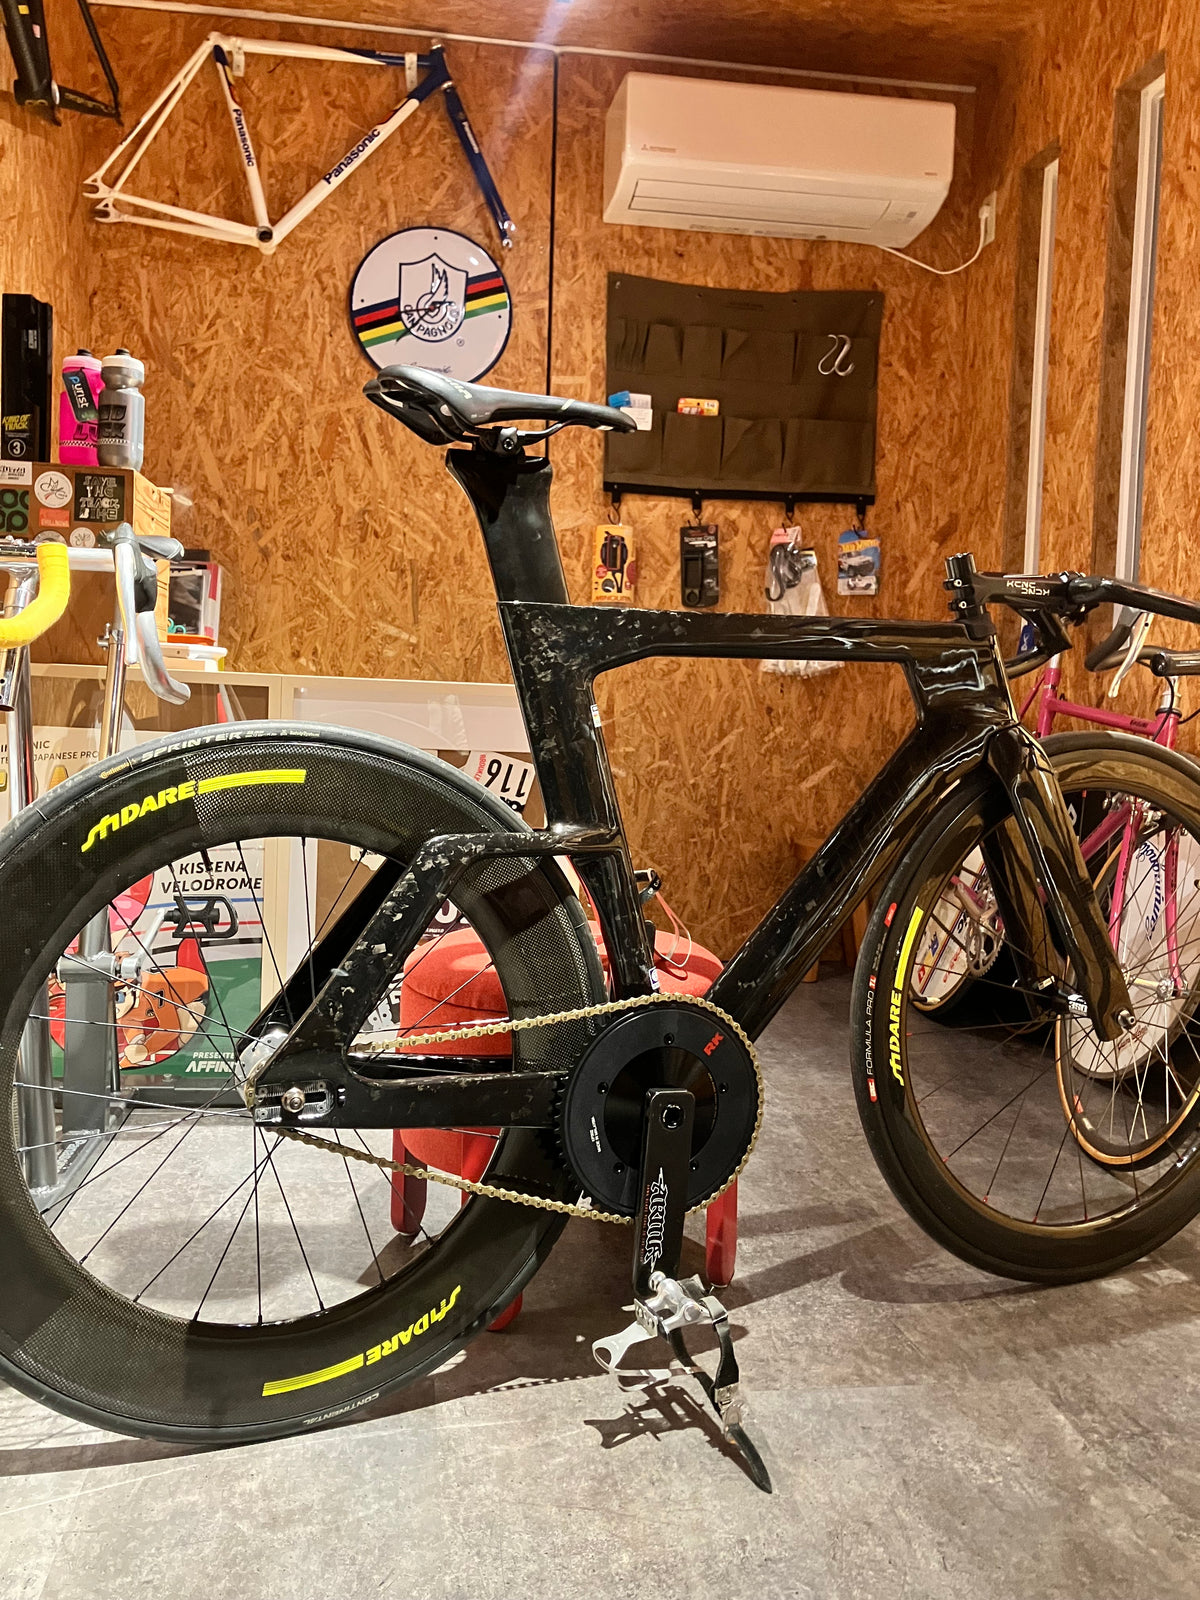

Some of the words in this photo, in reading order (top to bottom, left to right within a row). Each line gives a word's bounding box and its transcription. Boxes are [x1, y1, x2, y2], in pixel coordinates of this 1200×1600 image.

[232, 108, 255, 167] Panasonic
[322, 128, 381, 185] Panasonic
[13, 441, 21, 455] 3
[1006, 580, 1037, 590] KCNC
[141, 731, 243, 763] SPRINTER
[484, 758, 529, 798] 116
[160, 877, 263, 894] VELODROME
[865, 990, 875, 1015] PRO
[192, 1051, 235, 1059] PRESENTE
[703, 1032, 725, 1056] RK
[865, 1019, 874, 1075] FORMULA
[302, 1391, 380, 1425] CONTINENTAL
